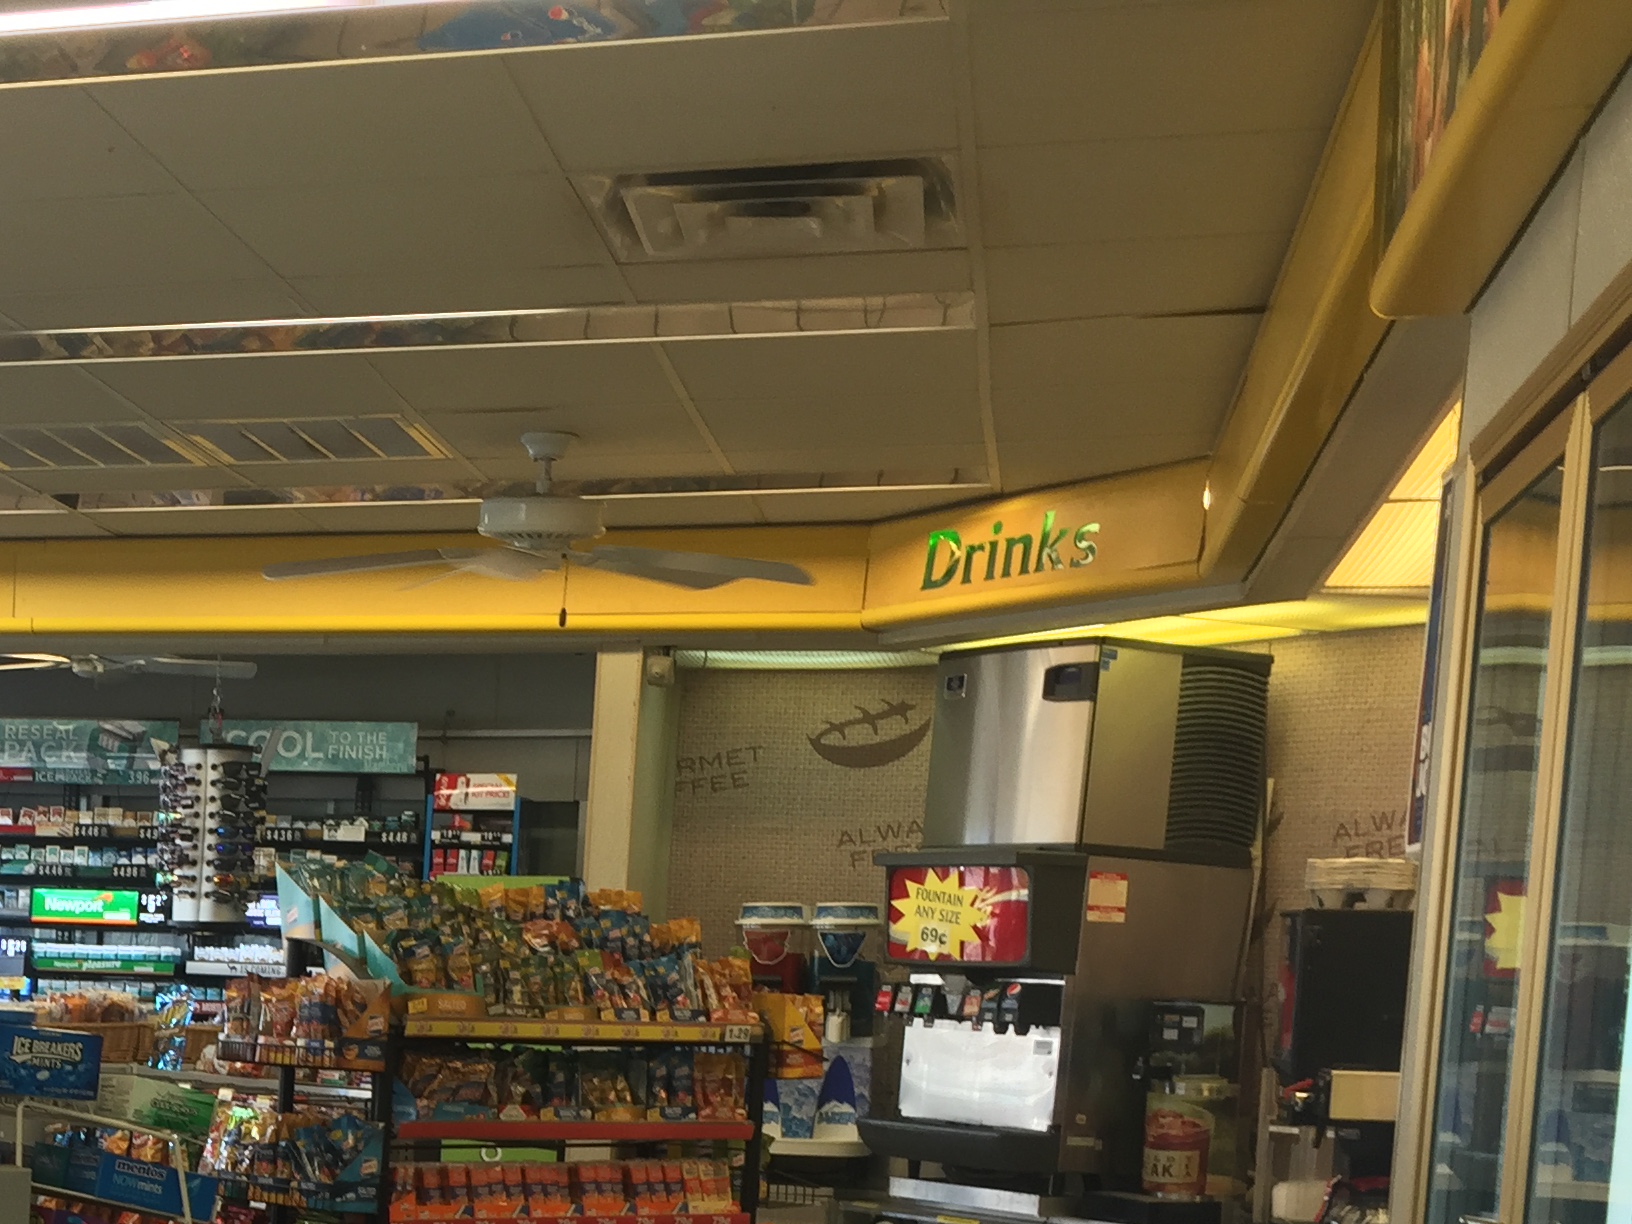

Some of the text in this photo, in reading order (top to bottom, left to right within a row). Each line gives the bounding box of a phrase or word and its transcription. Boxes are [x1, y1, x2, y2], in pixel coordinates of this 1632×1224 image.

[920, 509, 1103, 593] Drinks
[4, 725, 79, 741] RESEAL
[329, 731, 387, 745] TO THE
[4, 741, 79, 763] PACK
[328, 745, 387, 760] FINISH
[676, 746, 763, 776] RMET
[675, 770, 750, 798] FFEE
[838, 820, 923, 848] ALWA
[1333, 809, 1406, 842] ALW
[1345, 834, 1406, 859] FRE
[44, 896, 104, 916] Newport
[915, 887, 963, 907] FOUNTAIN
[914, 904, 962, 925] ANY SIZE
[13, 1036, 83, 1061] ICE BREAKERS
[116, 1160, 166, 1180] mentos
